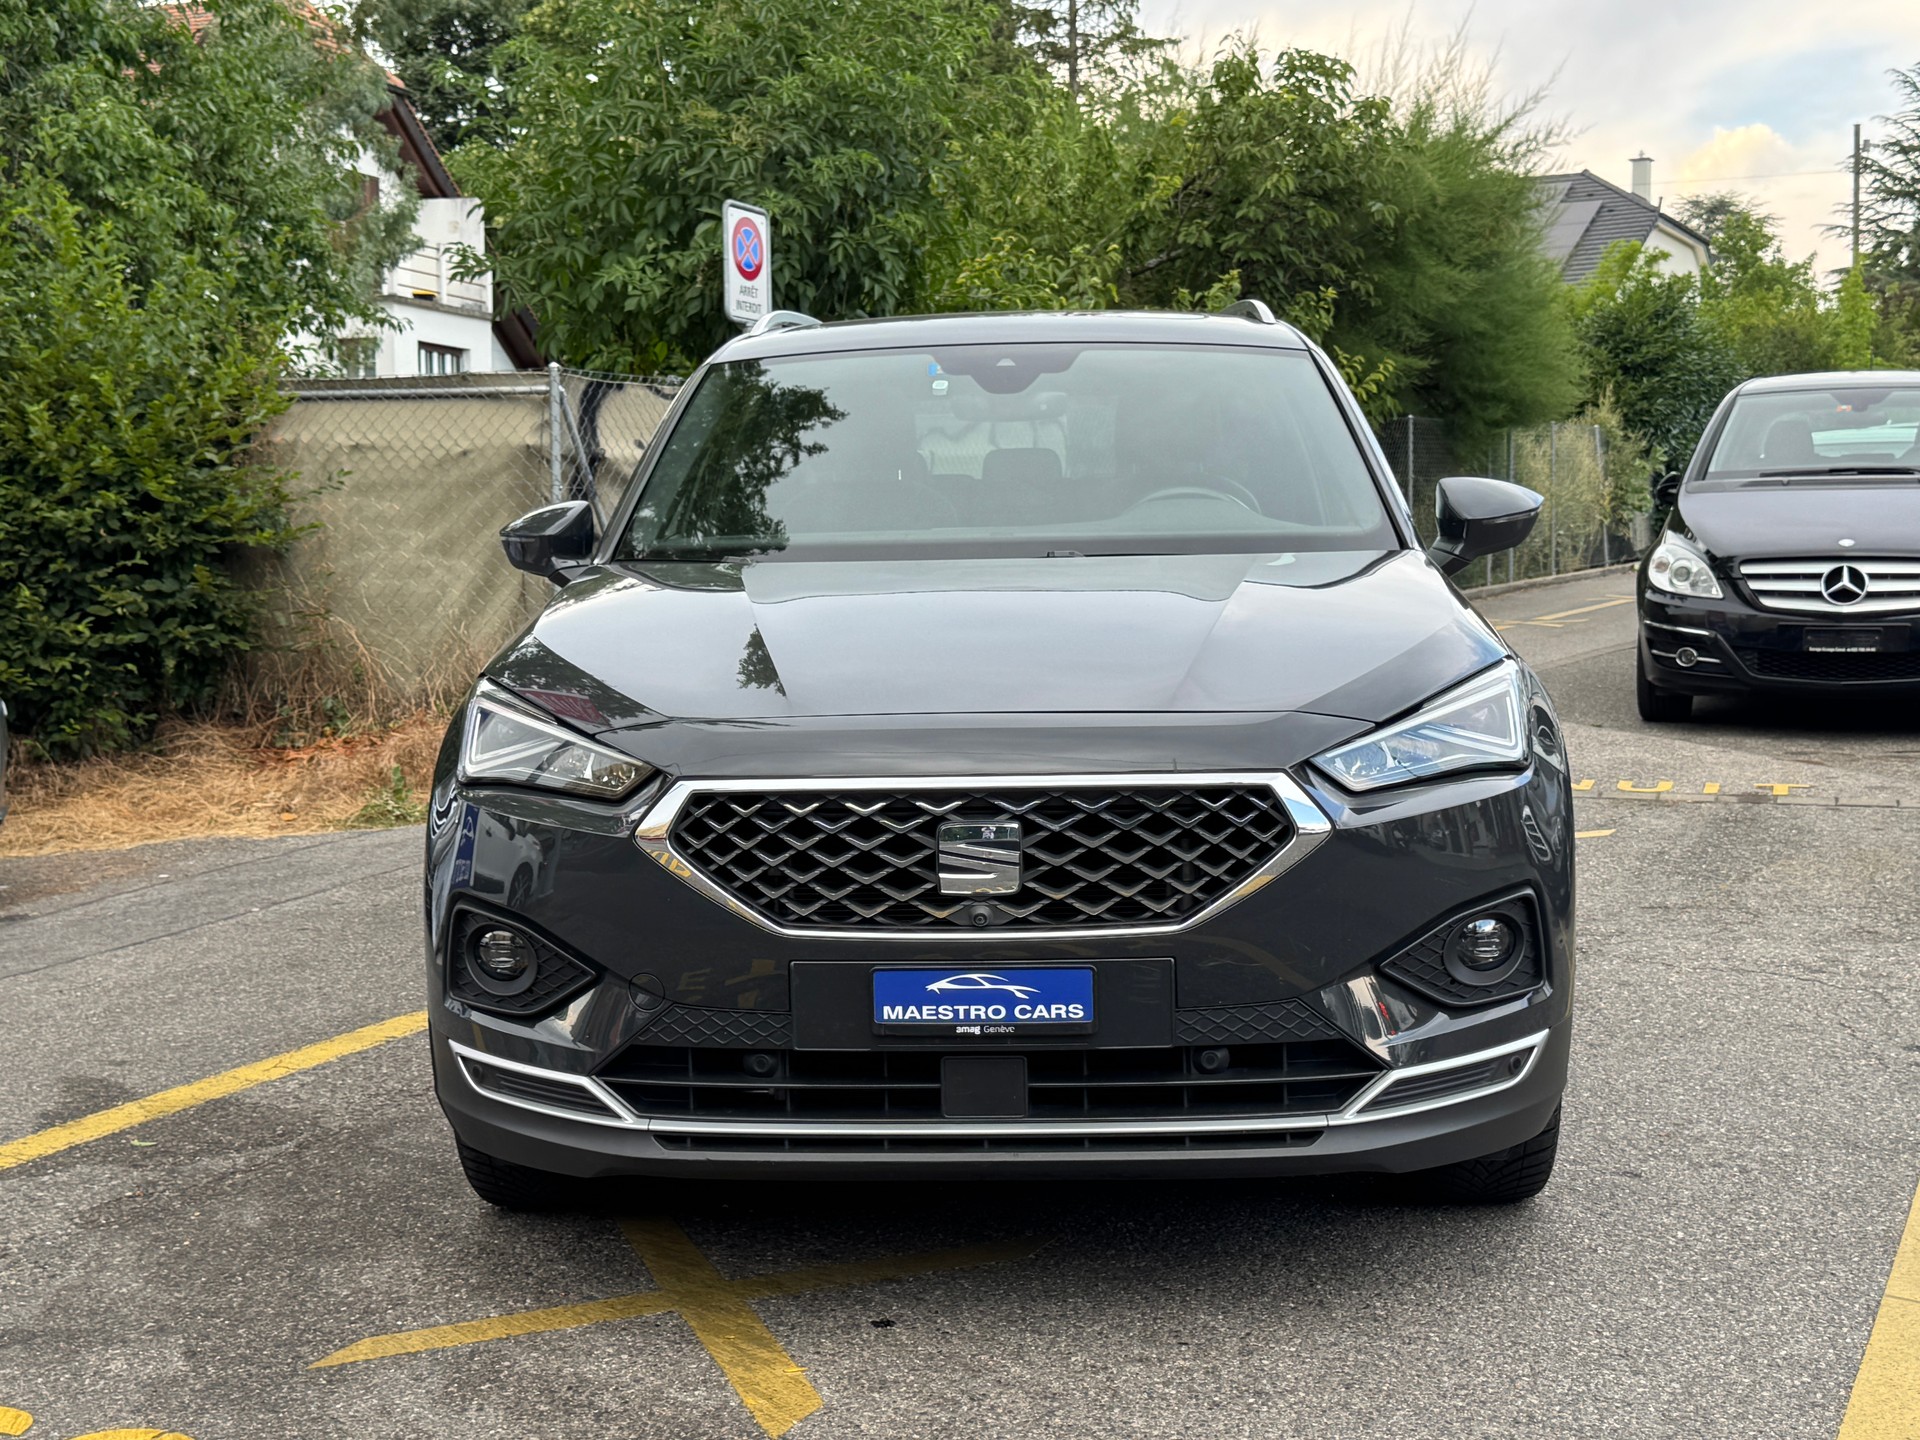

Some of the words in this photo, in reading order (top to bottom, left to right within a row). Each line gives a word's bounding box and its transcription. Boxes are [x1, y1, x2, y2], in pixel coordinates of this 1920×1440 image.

[739, 284, 759, 298] ARRÊT
[882, 1004, 1007, 1020] MAESTRO
[1013, 1003, 1085, 1020] CARS
[956, 1025, 981, 1035] amag
